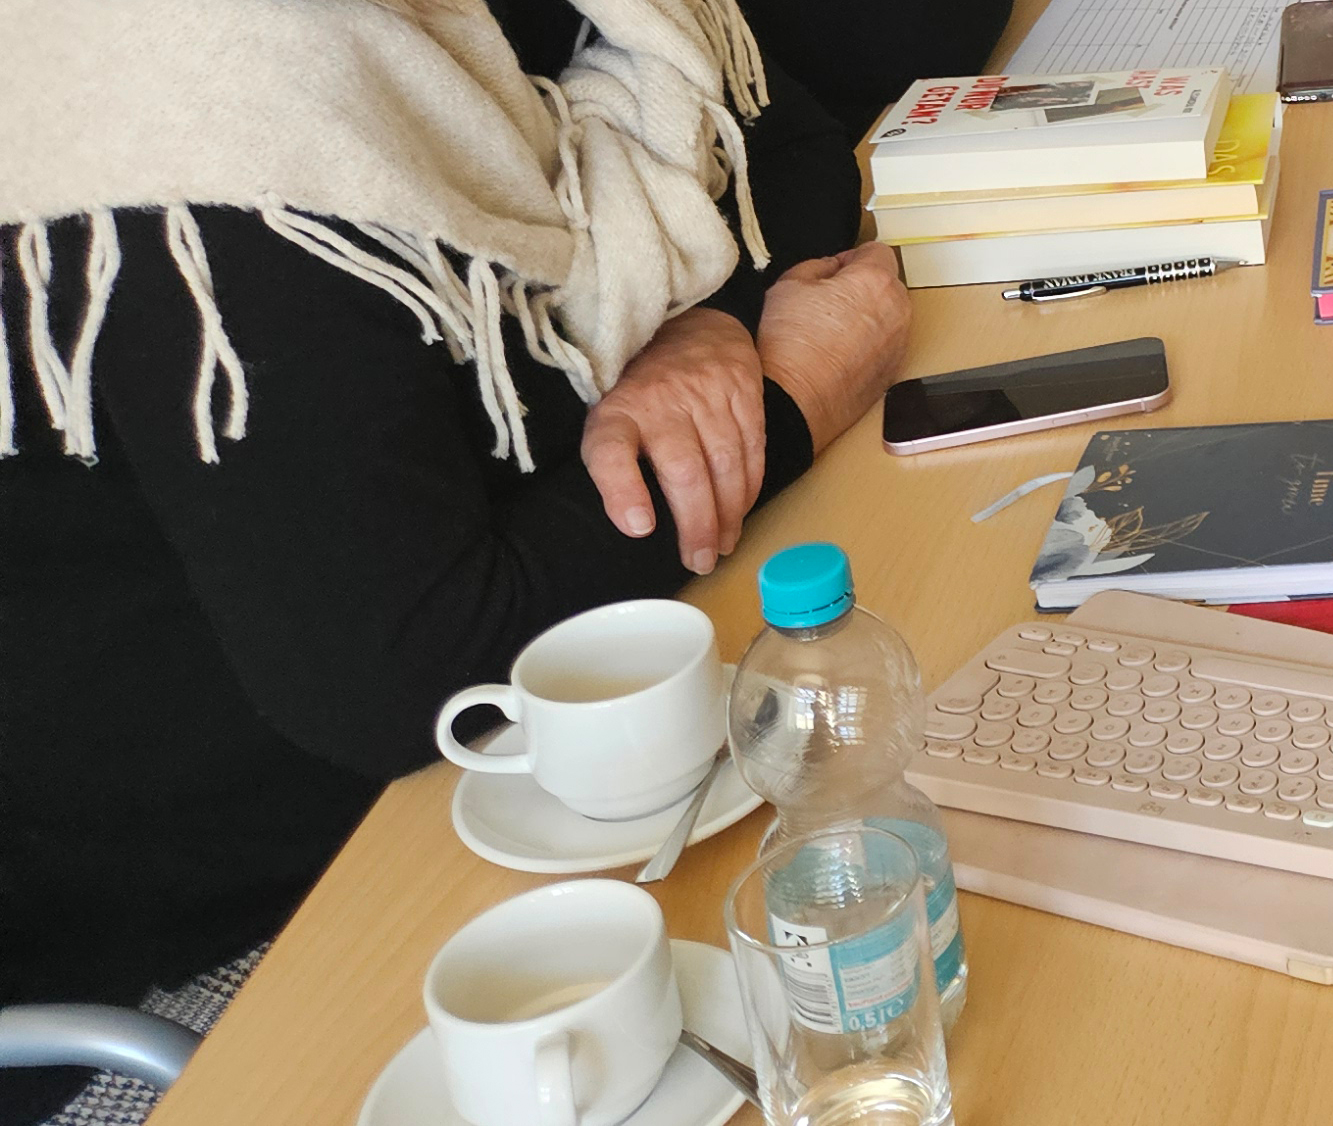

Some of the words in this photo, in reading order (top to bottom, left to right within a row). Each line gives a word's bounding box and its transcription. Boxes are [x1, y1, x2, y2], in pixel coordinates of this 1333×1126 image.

[970, 76, 1010, 90] DU
[1125, 69, 1160, 89] HAST
[1154, 75, 1191, 97] WAS
[901, 85, 960, 126] GETAN?
[954, 88, 999, 112] NUR
[1208, 139, 1239, 175] DAS
[1093, 268, 1136, 281] FRANK
[849, 1011, 877, 1031] 0,5
